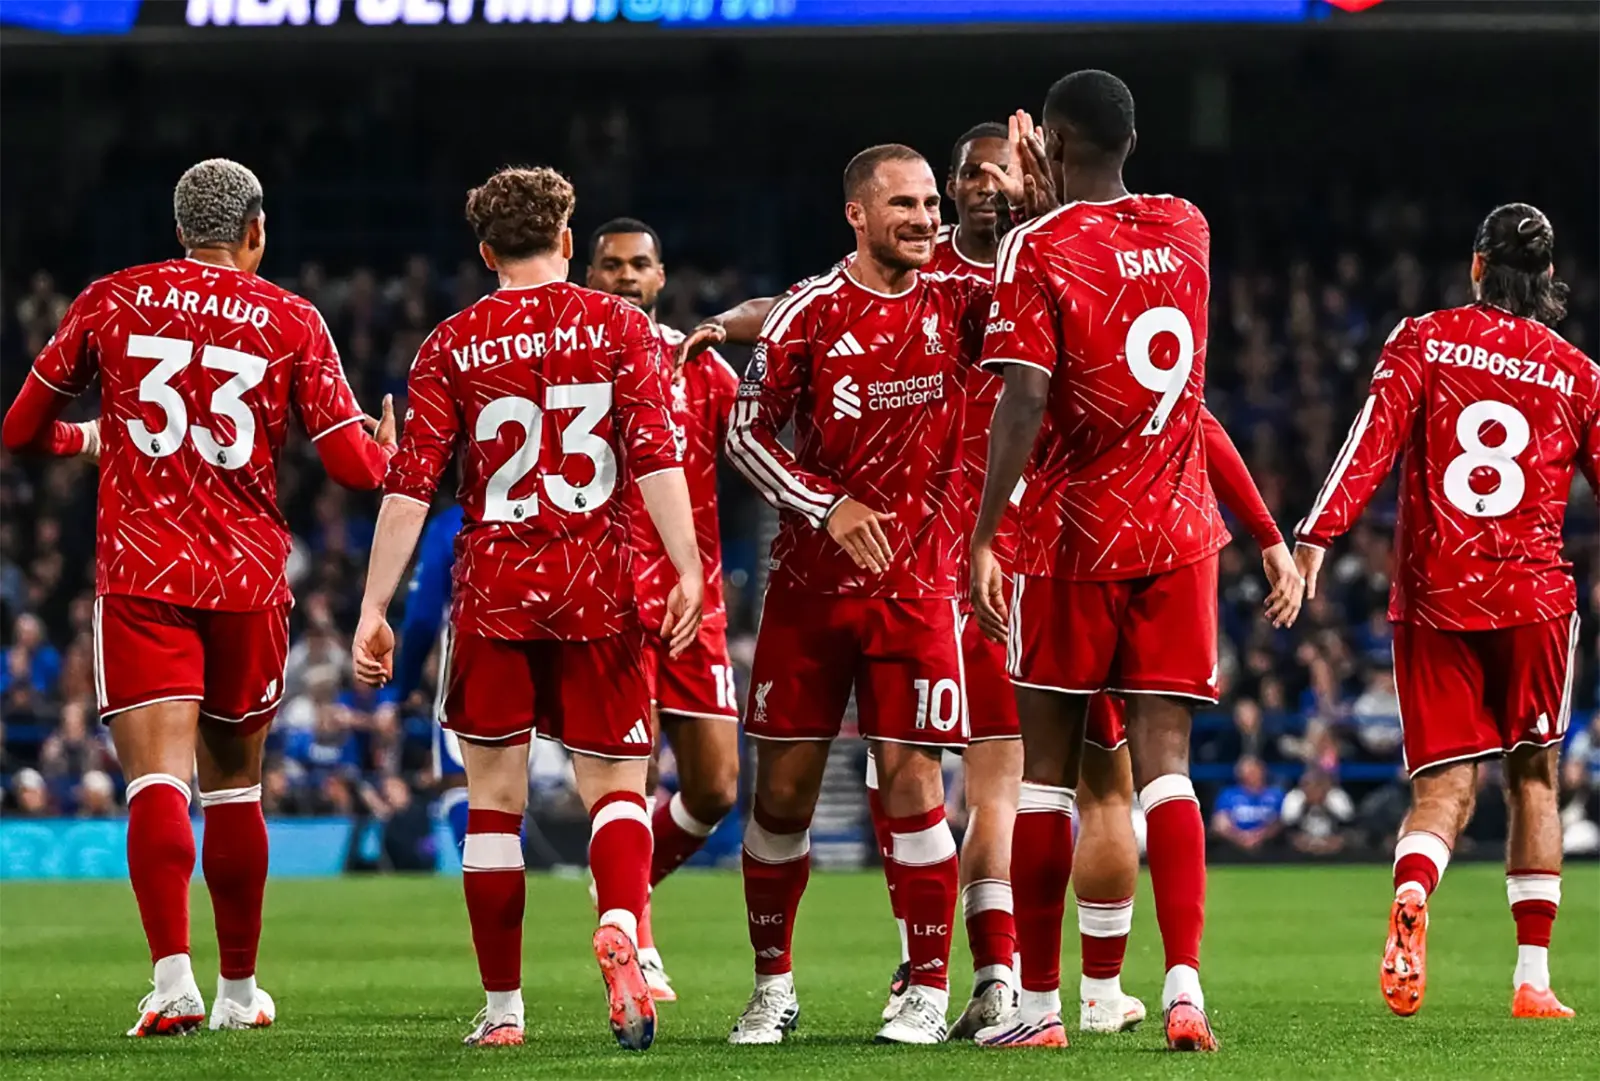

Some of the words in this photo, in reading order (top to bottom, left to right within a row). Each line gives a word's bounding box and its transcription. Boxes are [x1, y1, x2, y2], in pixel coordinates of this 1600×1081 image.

[1115, 247, 1177, 277] ISAK
[136, 284, 270, 328] R.ARAUJO
[452, 331, 546, 373] VÍCTOR
[555, 323, 611, 352] M.V.
[1125, 306, 1194, 436] 9
[1424, 338, 1575, 397] SZOBOSZLAI
[126, 334, 268, 470] 33
[867, 371, 943, 396] standard
[475, 382, 617, 522] 23
[1443, 400, 1530, 517] 8
[914, 678, 960, 731] 10
[750, 911, 783, 926] LFC
[913, 923, 947, 936] LFC
